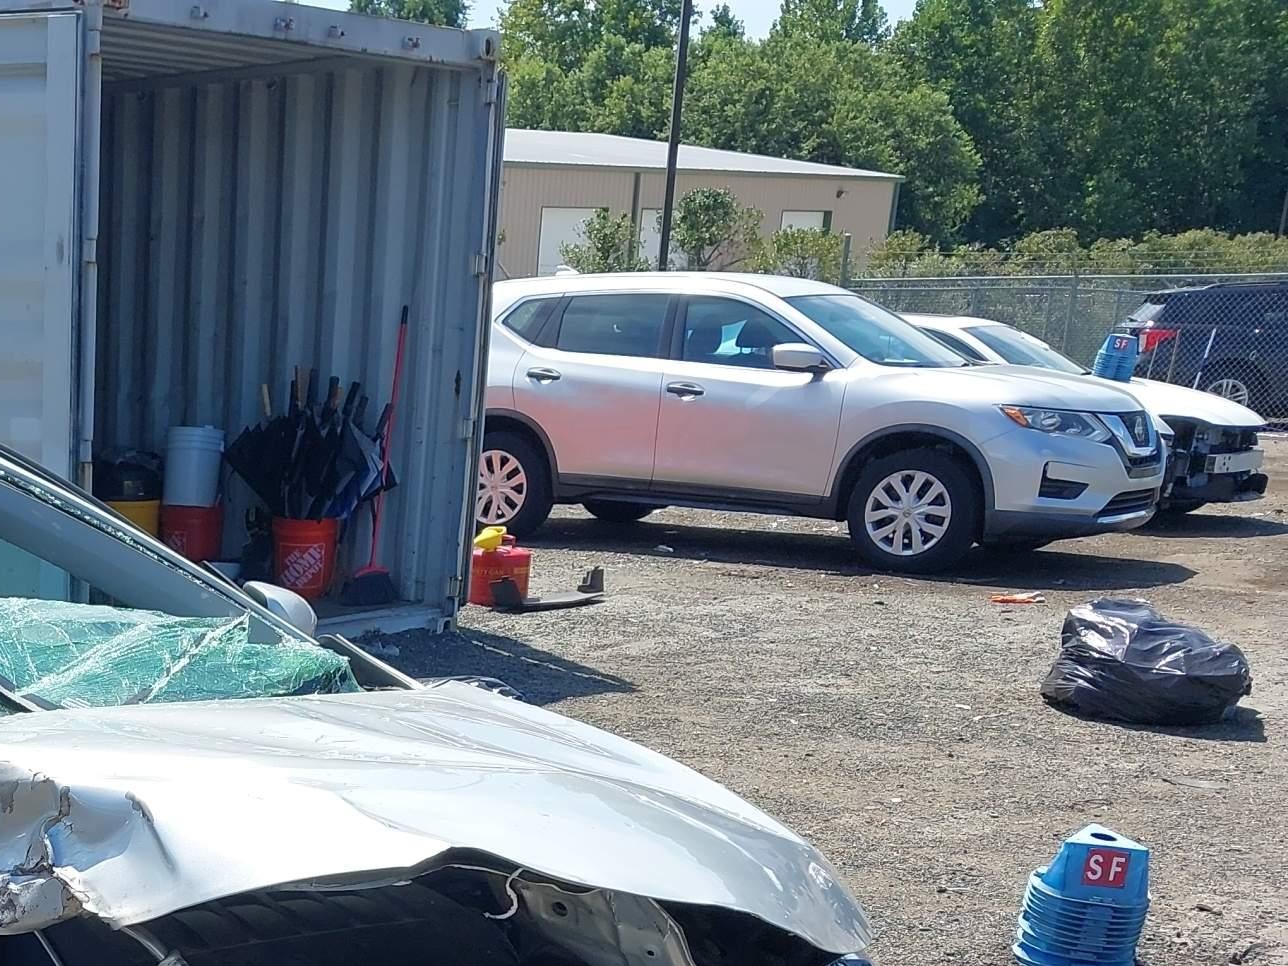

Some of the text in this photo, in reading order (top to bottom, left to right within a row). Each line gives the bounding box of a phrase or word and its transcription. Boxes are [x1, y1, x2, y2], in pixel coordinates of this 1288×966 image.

[1114, 338, 1129, 350] SF
[280, 545, 323, 586] HOME
[1085, 854, 1126, 881] SF
